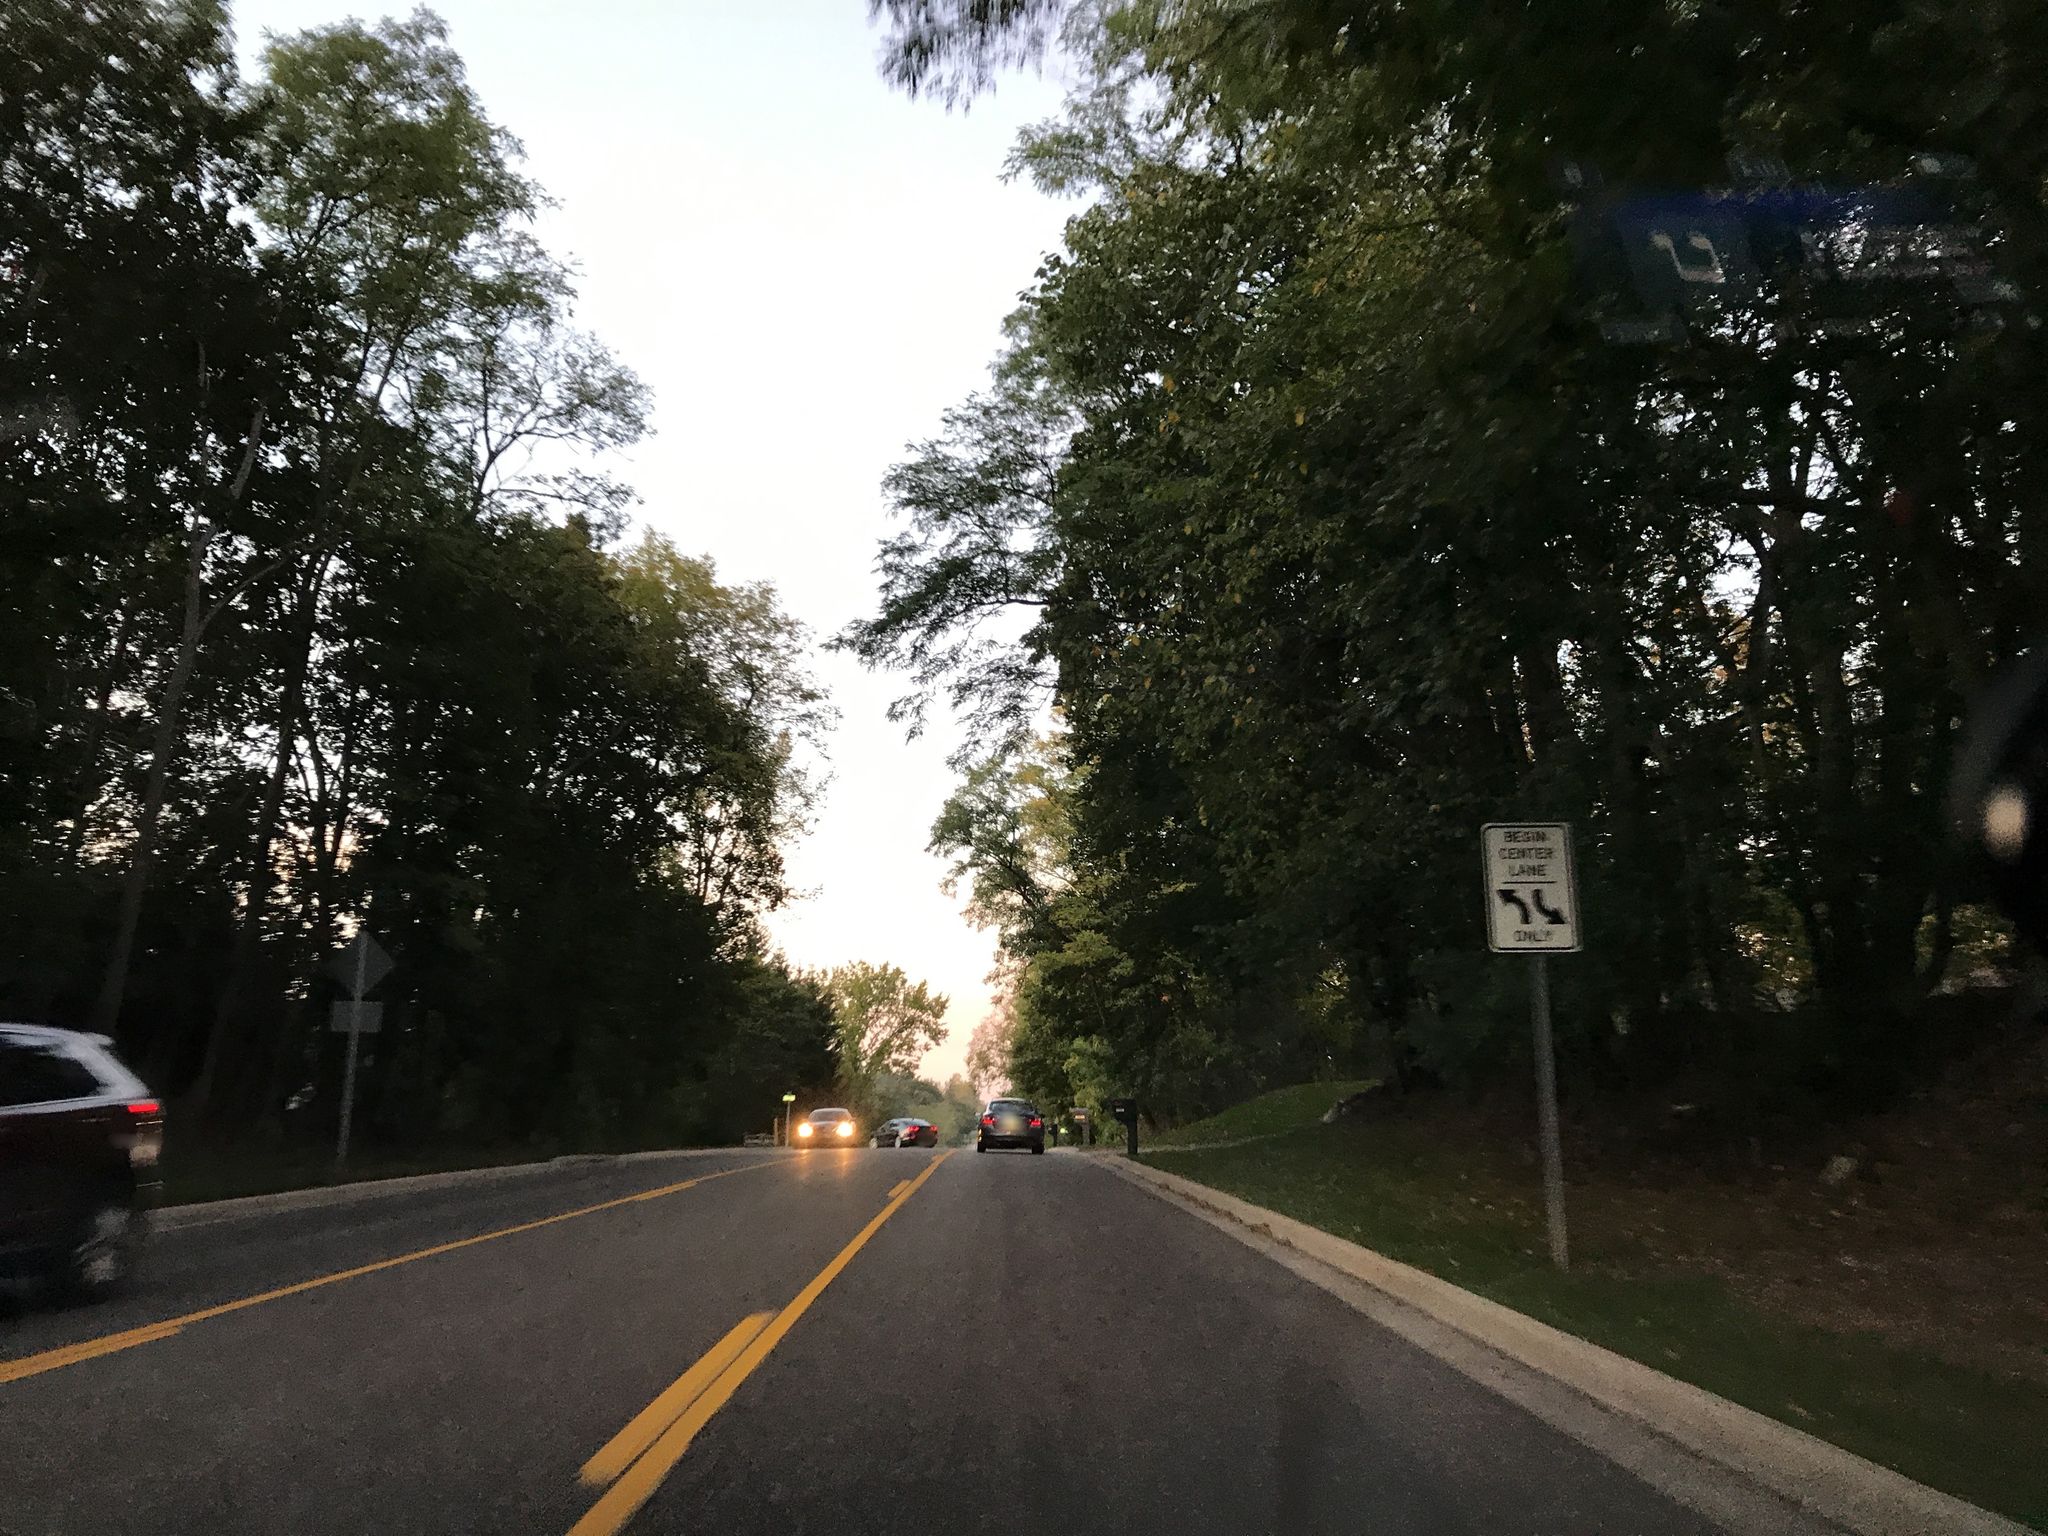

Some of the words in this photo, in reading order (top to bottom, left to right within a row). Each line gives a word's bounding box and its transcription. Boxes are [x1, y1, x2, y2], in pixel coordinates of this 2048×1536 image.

[1504, 831, 1547, 843] BEGIN
[1498, 847, 1554, 860] CENTER
[1508, 864, 1548, 876] LANE
[1514, 930, 1553, 942] ONLY
